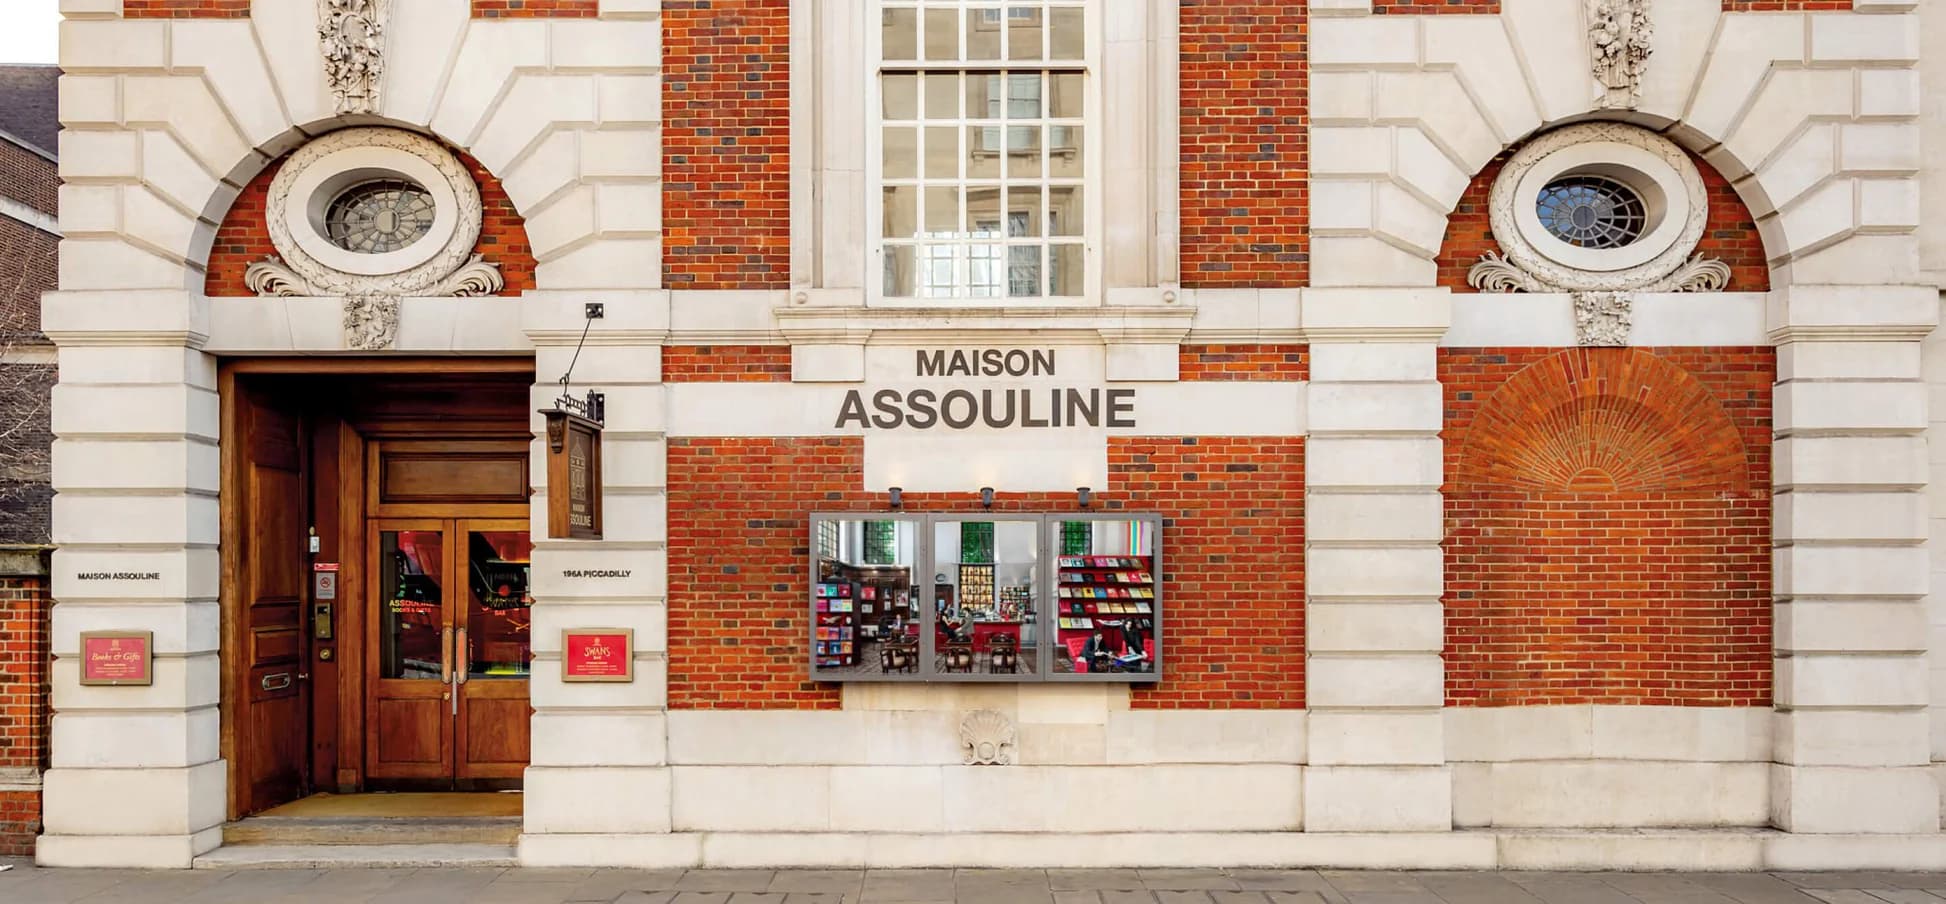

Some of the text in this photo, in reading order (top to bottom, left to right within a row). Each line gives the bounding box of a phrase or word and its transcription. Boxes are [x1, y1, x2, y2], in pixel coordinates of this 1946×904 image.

[916, 349, 1055, 377] MAISON
[834, 388, 1136, 429] ASSOULINE
[78, 572, 160, 580] MAISON ASSOULINE
[563, 570, 632, 578] 196A PICCADILLY
[584, 646, 611, 657] SWANS
[91, 652, 112, 661] Books
[123, 652, 141, 663] Gifts
